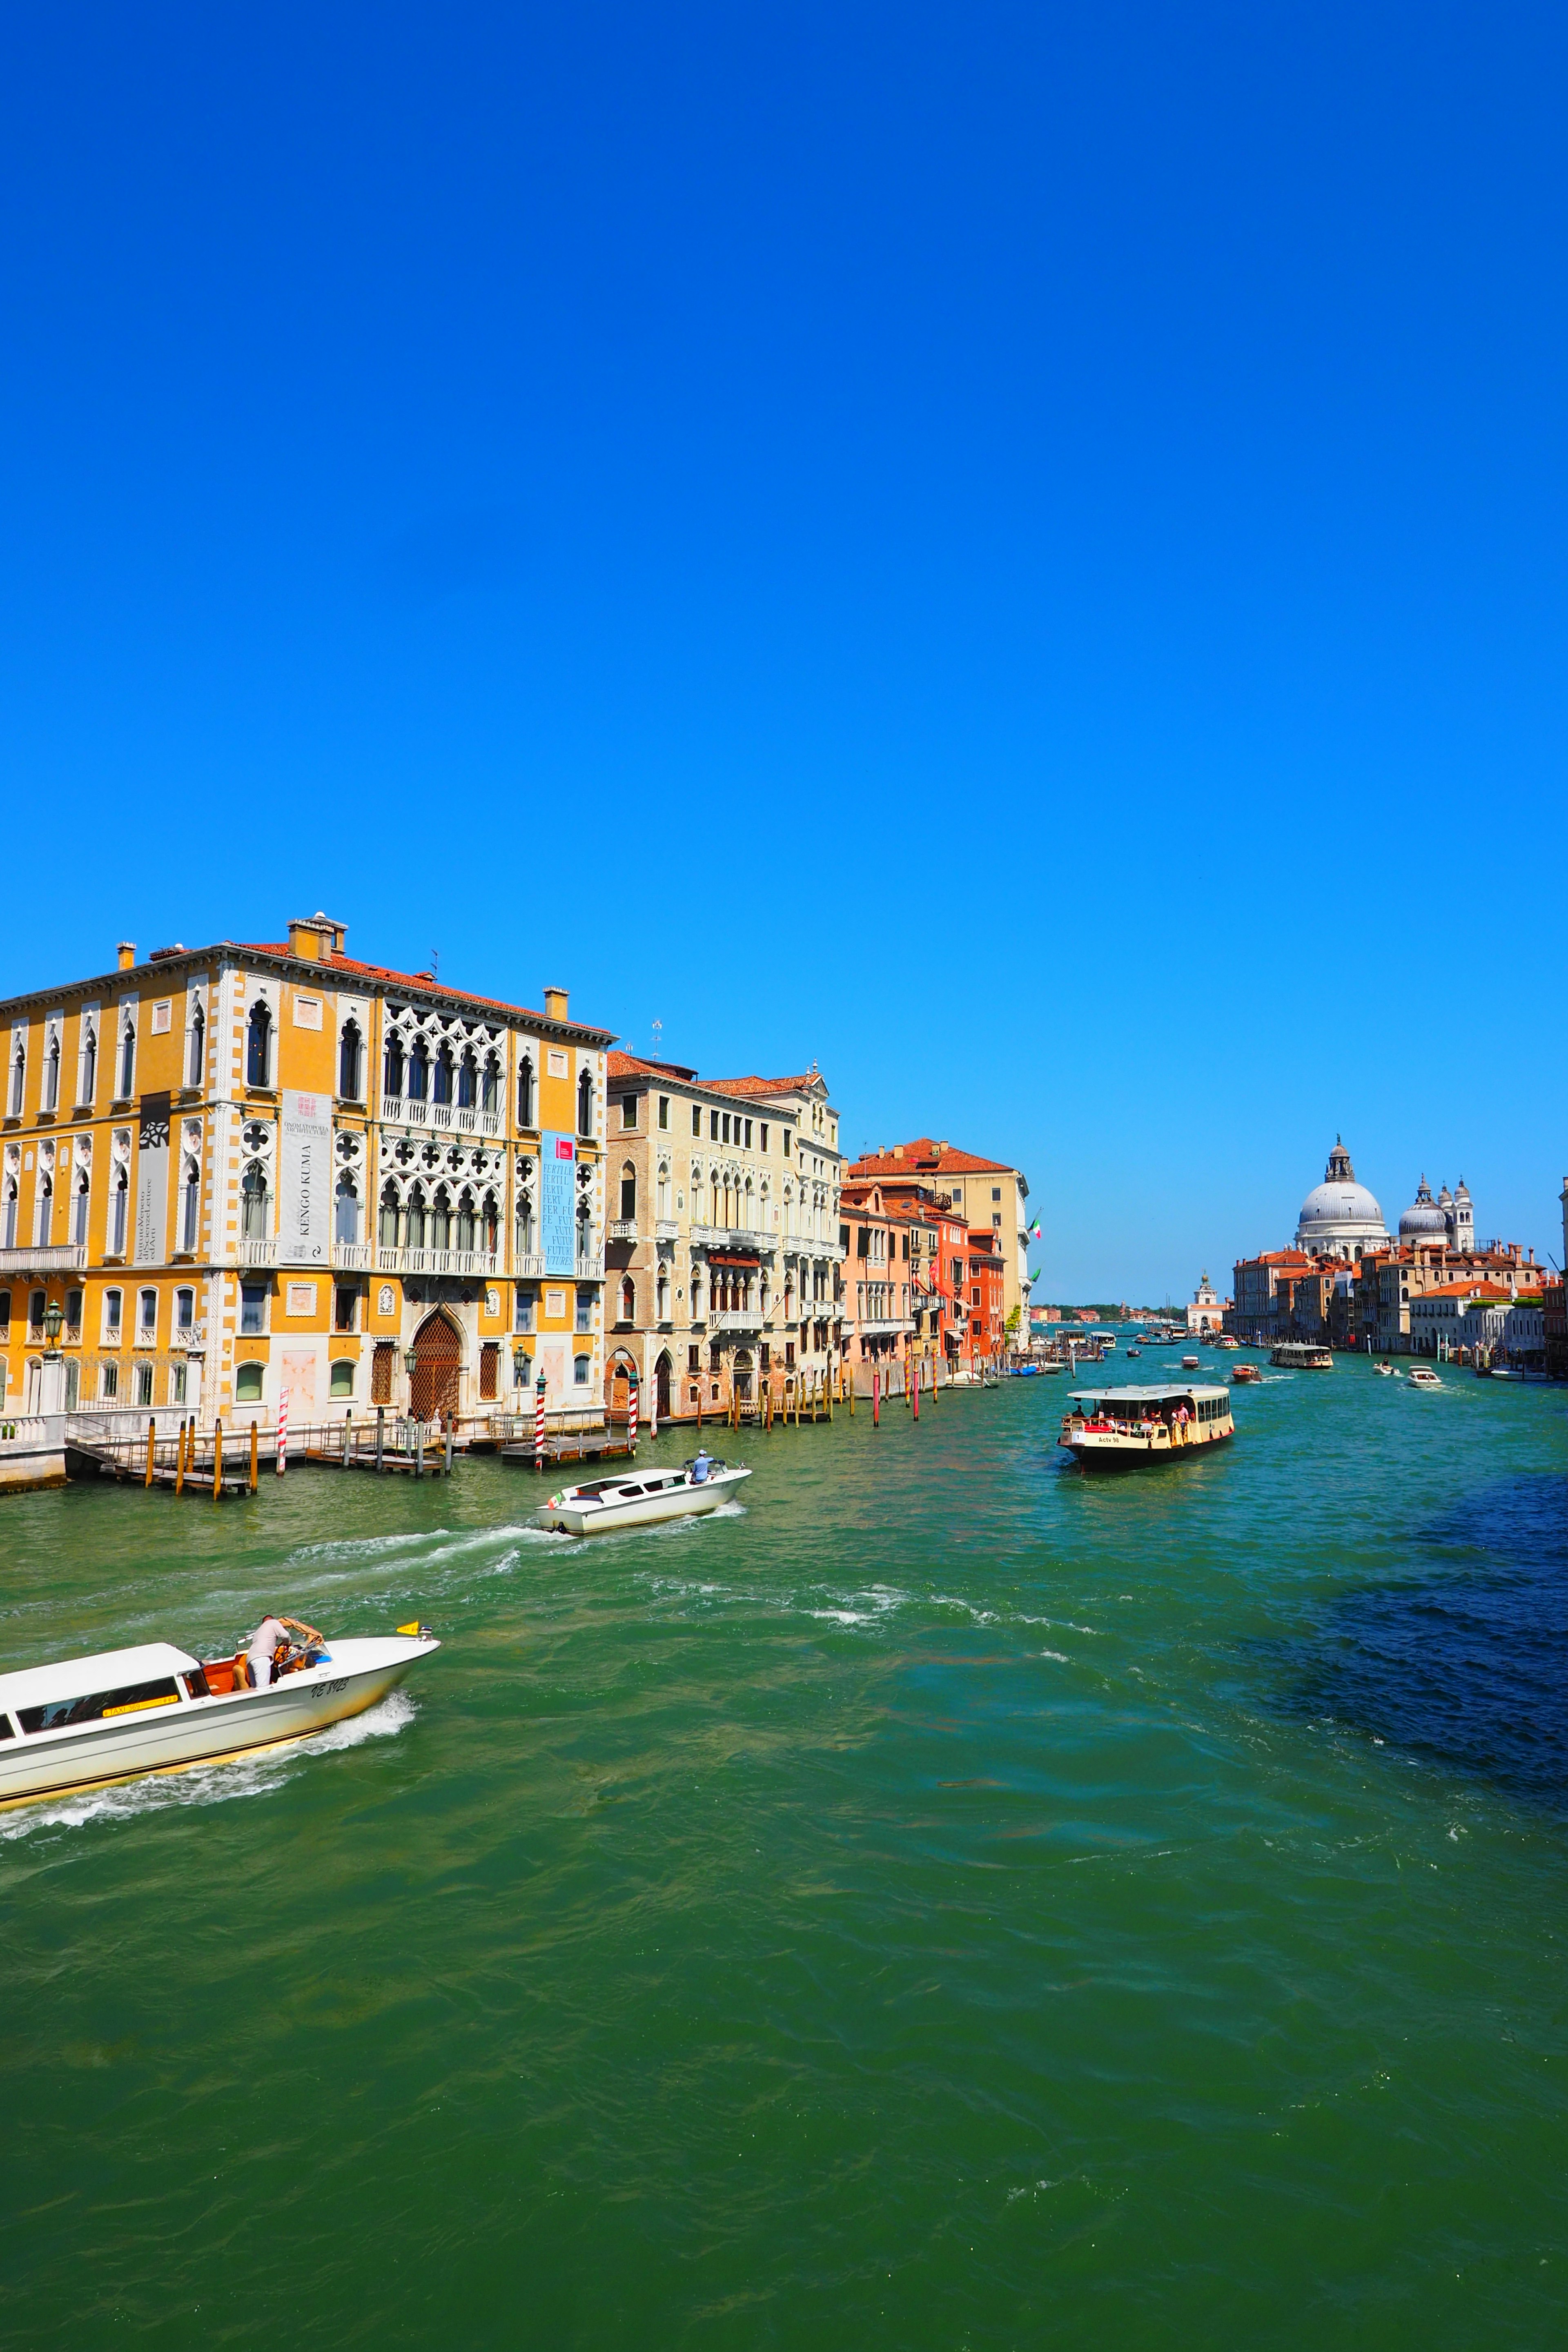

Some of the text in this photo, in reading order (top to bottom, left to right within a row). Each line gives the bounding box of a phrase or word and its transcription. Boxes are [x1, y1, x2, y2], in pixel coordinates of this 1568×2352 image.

[286, 1127, 327, 1136] ARCHITECTURE
[543, 1164, 573, 1176] FERTILE
[543, 1174, 569, 1185] FERTIL
[300, 1145, 311, 1235] KENGO KUMA
[543, 1184, 563, 1194] FERTI
[543, 1194, 573, 1205] FERT F
[543, 1205, 573, 1216] FER FU
[543, 1215, 573, 1225] FE FUT
[543, 1225, 547, 1234] F
[555, 1226, 573, 1236] FUTU
[552, 1236, 573, 1245] FUTUR
[548, 1245, 573, 1256] FUTURE
[546, 1256, 573, 1266] UTURES
[311, 1684, 326, 1698] VE
[109, 1707, 125, 1715] TAXI
